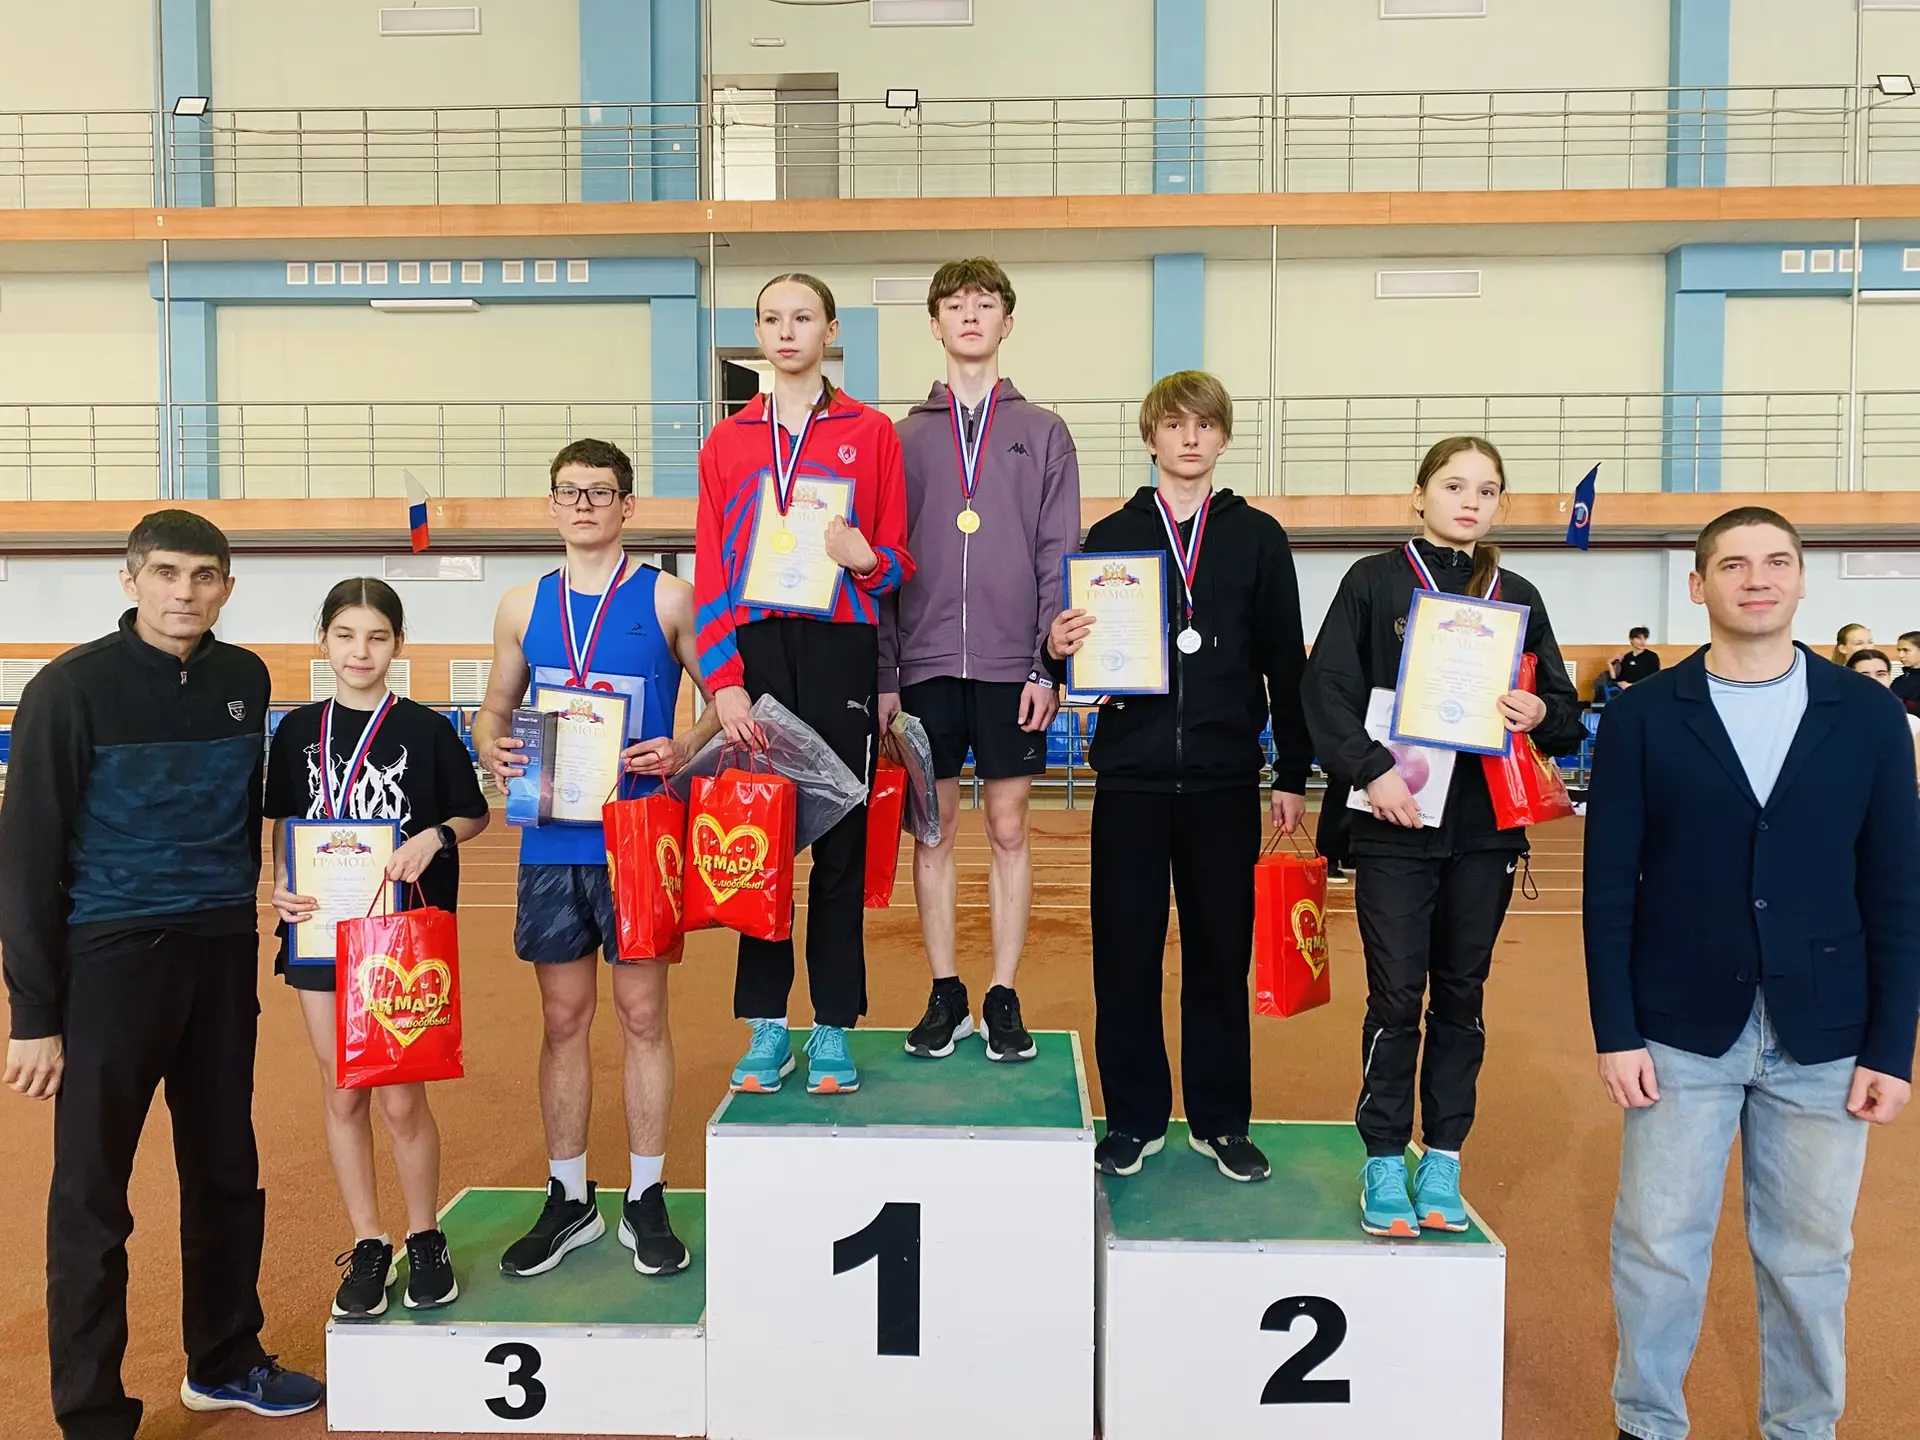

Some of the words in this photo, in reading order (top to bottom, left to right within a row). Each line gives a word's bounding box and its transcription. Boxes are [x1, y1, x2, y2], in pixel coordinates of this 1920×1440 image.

[1087, 588, 1145, 601] ГРАМОТА
[1430, 632, 1497, 652] ГРАМОТА
[558, 722, 607, 739] РАМОТА
[312, 856, 376, 868] ГРАМОТА
[692, 853, 765, 875] ARMADA
[364, 993, 450, 1016] ARMADA
[833, 1202, 921, 1356] 1
[1260, 1295, 1350, 1405] 2
[484, 1342, 547, 1420] 3
